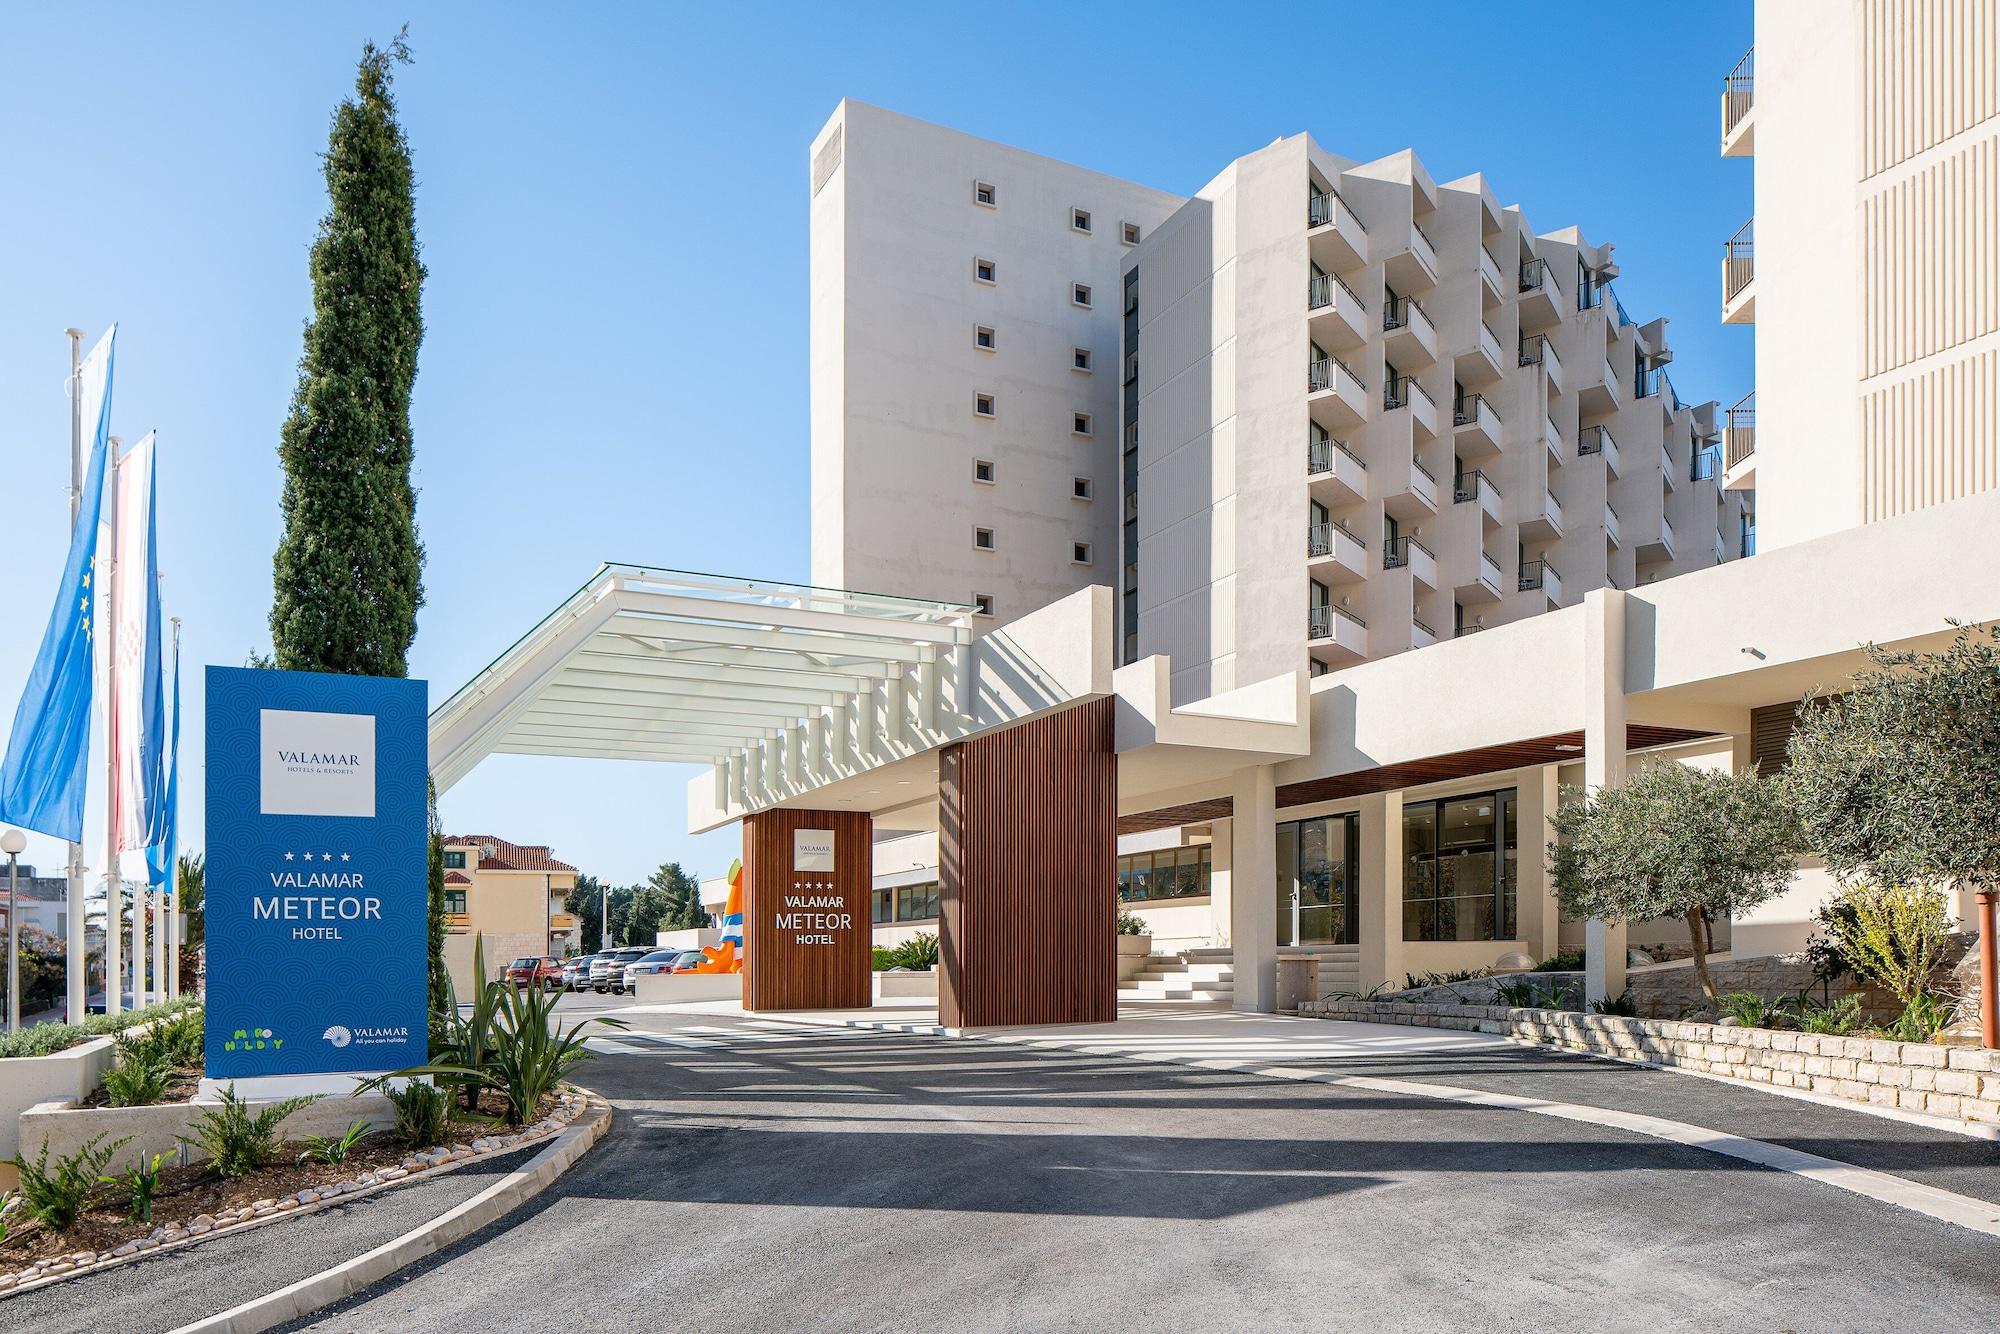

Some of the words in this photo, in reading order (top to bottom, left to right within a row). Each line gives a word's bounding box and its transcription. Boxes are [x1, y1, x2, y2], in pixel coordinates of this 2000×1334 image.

[278, 751, 360, 766] VALAMAR
[270, 872, 363, 889] VALAMAR
[252, 897, 382, 920] METEOR
[785, 896, 844, 908] VALAMAR
[776, 913, 852, 930] METEOR
[292, 927, 342, 940] HOTEL
[796, 934, 835, 945] HOTEL
[353, 1027, 409, 1037] VALAMAR
[224, 1039, 284, 1052] HOLIDAY
[386, 1037, 407, 1045] holiday
